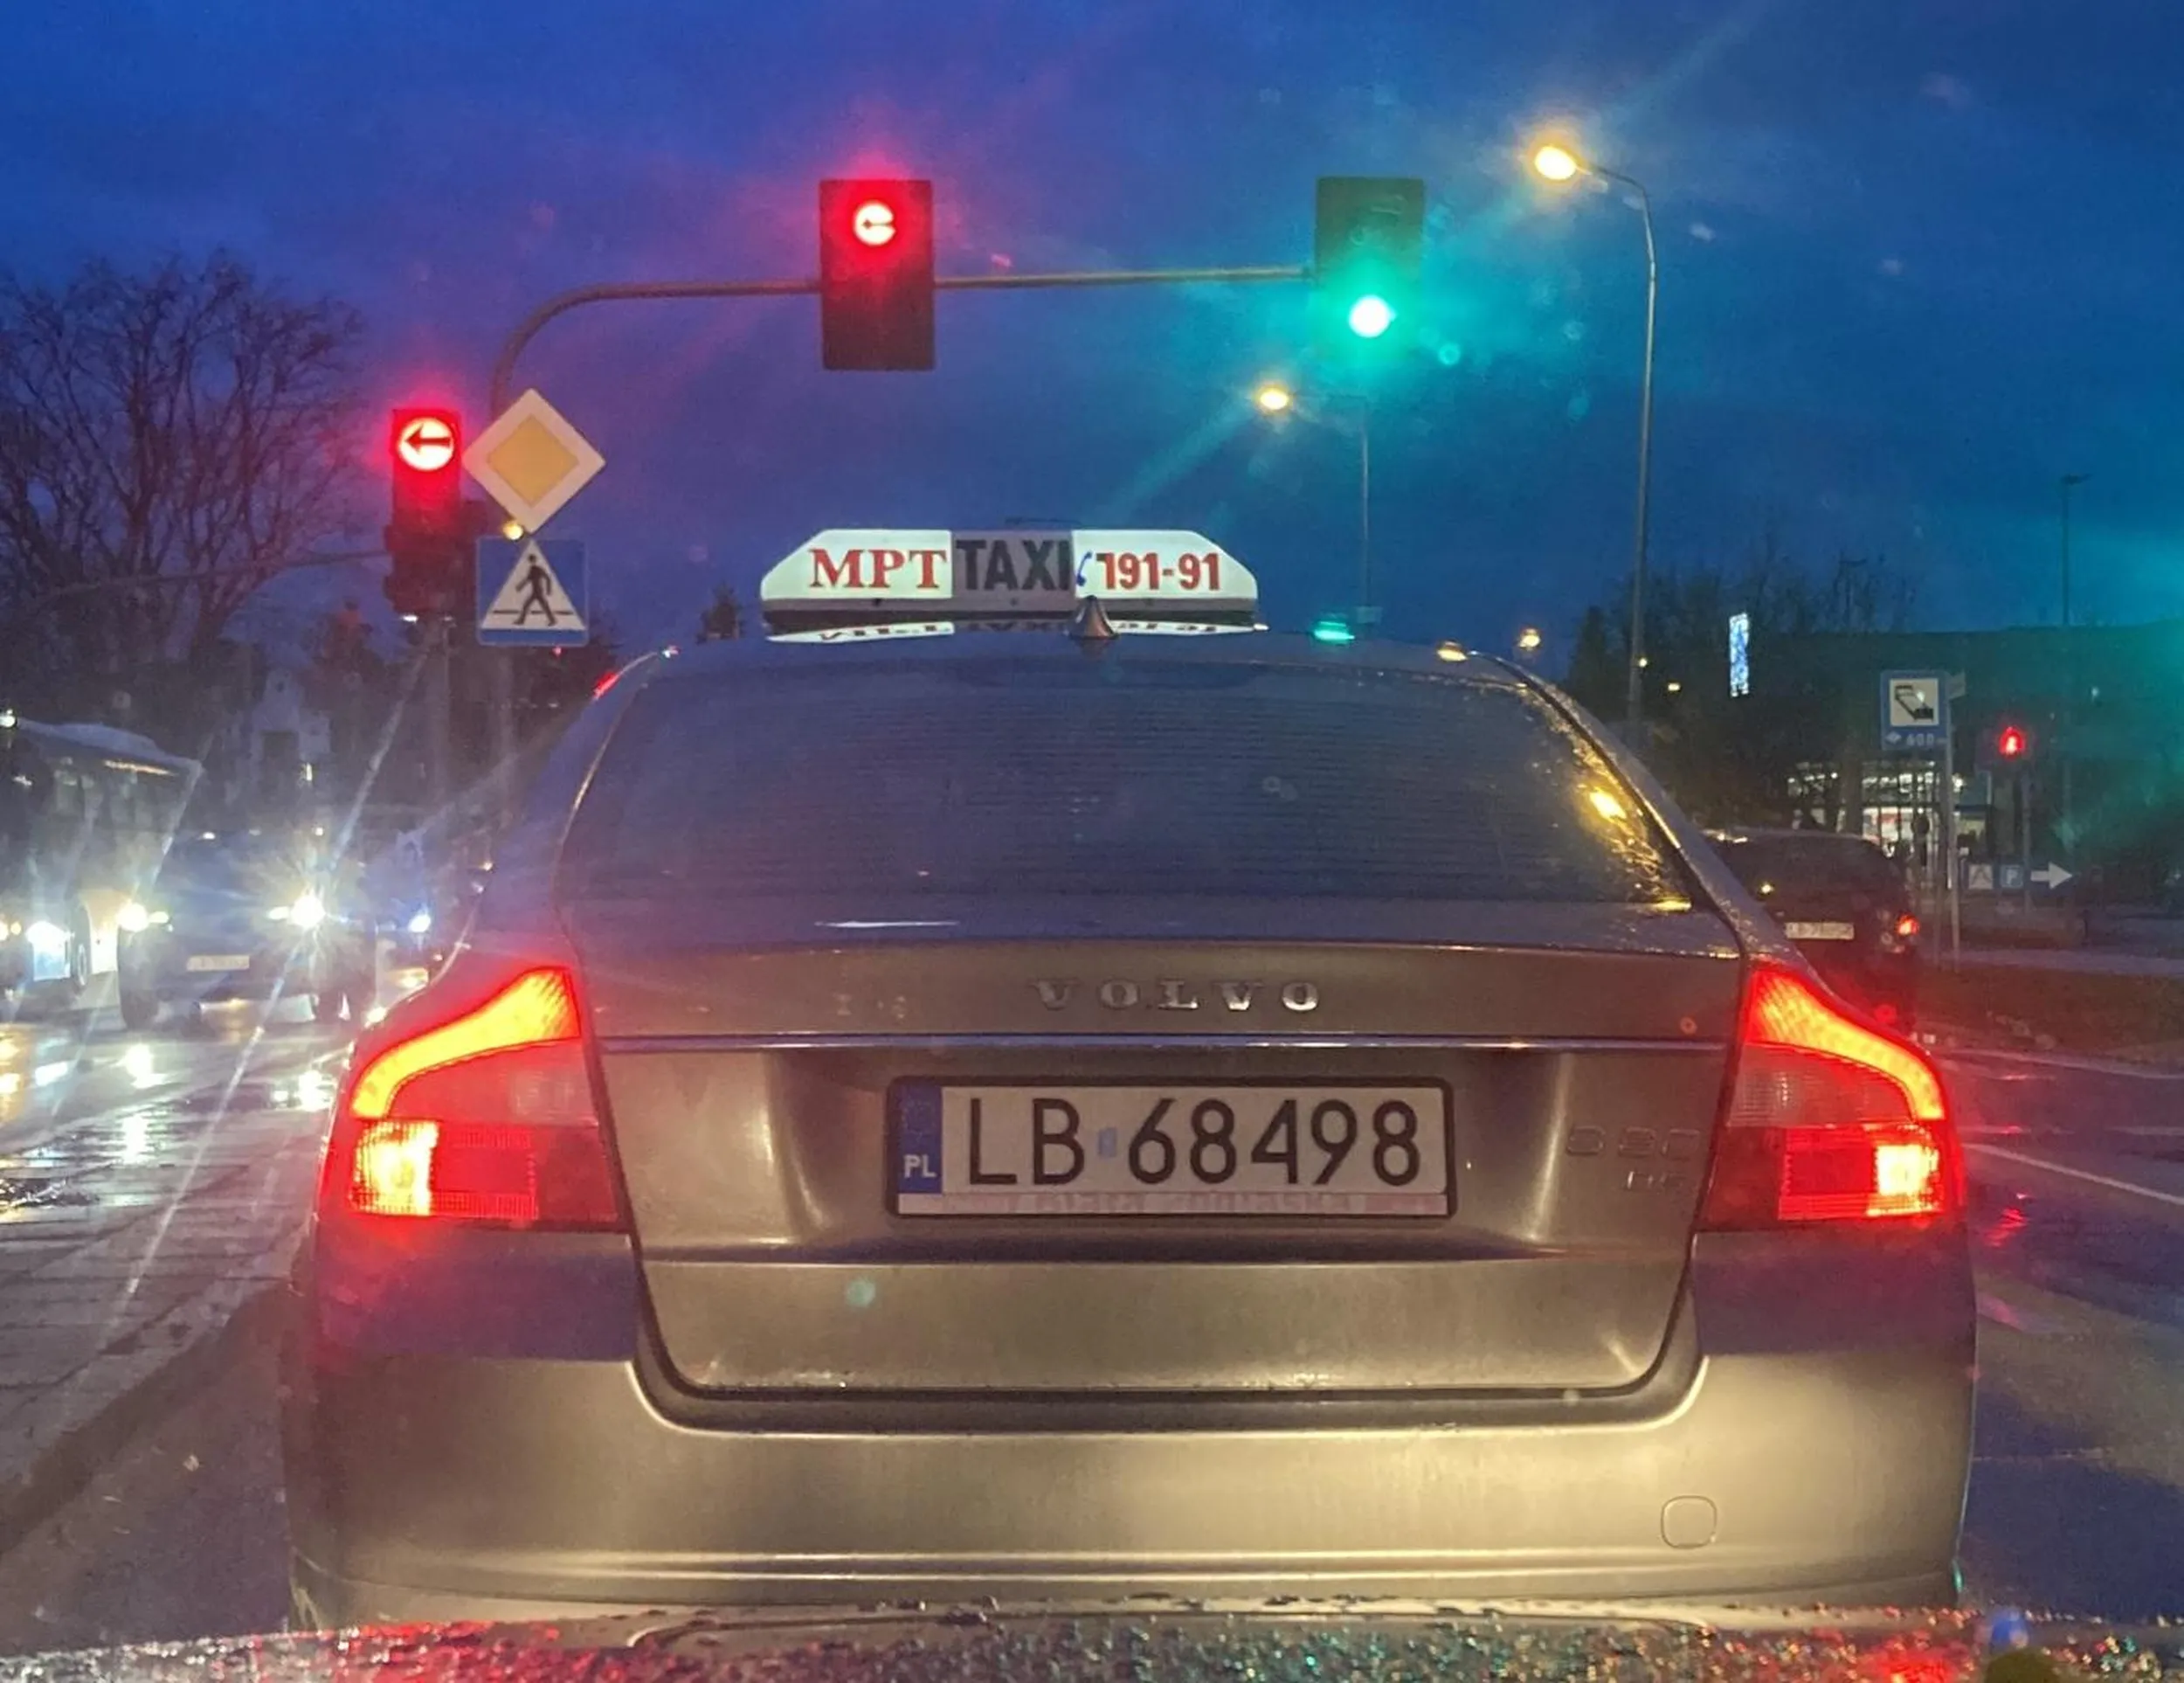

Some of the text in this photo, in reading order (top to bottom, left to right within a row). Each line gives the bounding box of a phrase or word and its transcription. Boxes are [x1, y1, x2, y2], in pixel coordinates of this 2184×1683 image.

[808, 548, 947, 589] MPT
[956, 539, 1070, 591] TAXI
[1029, 978, 1321, 1011] VOLVO
[969, 1098, 1420, 1187] LB 68498
[903, 1153, 937, 1179] PL
